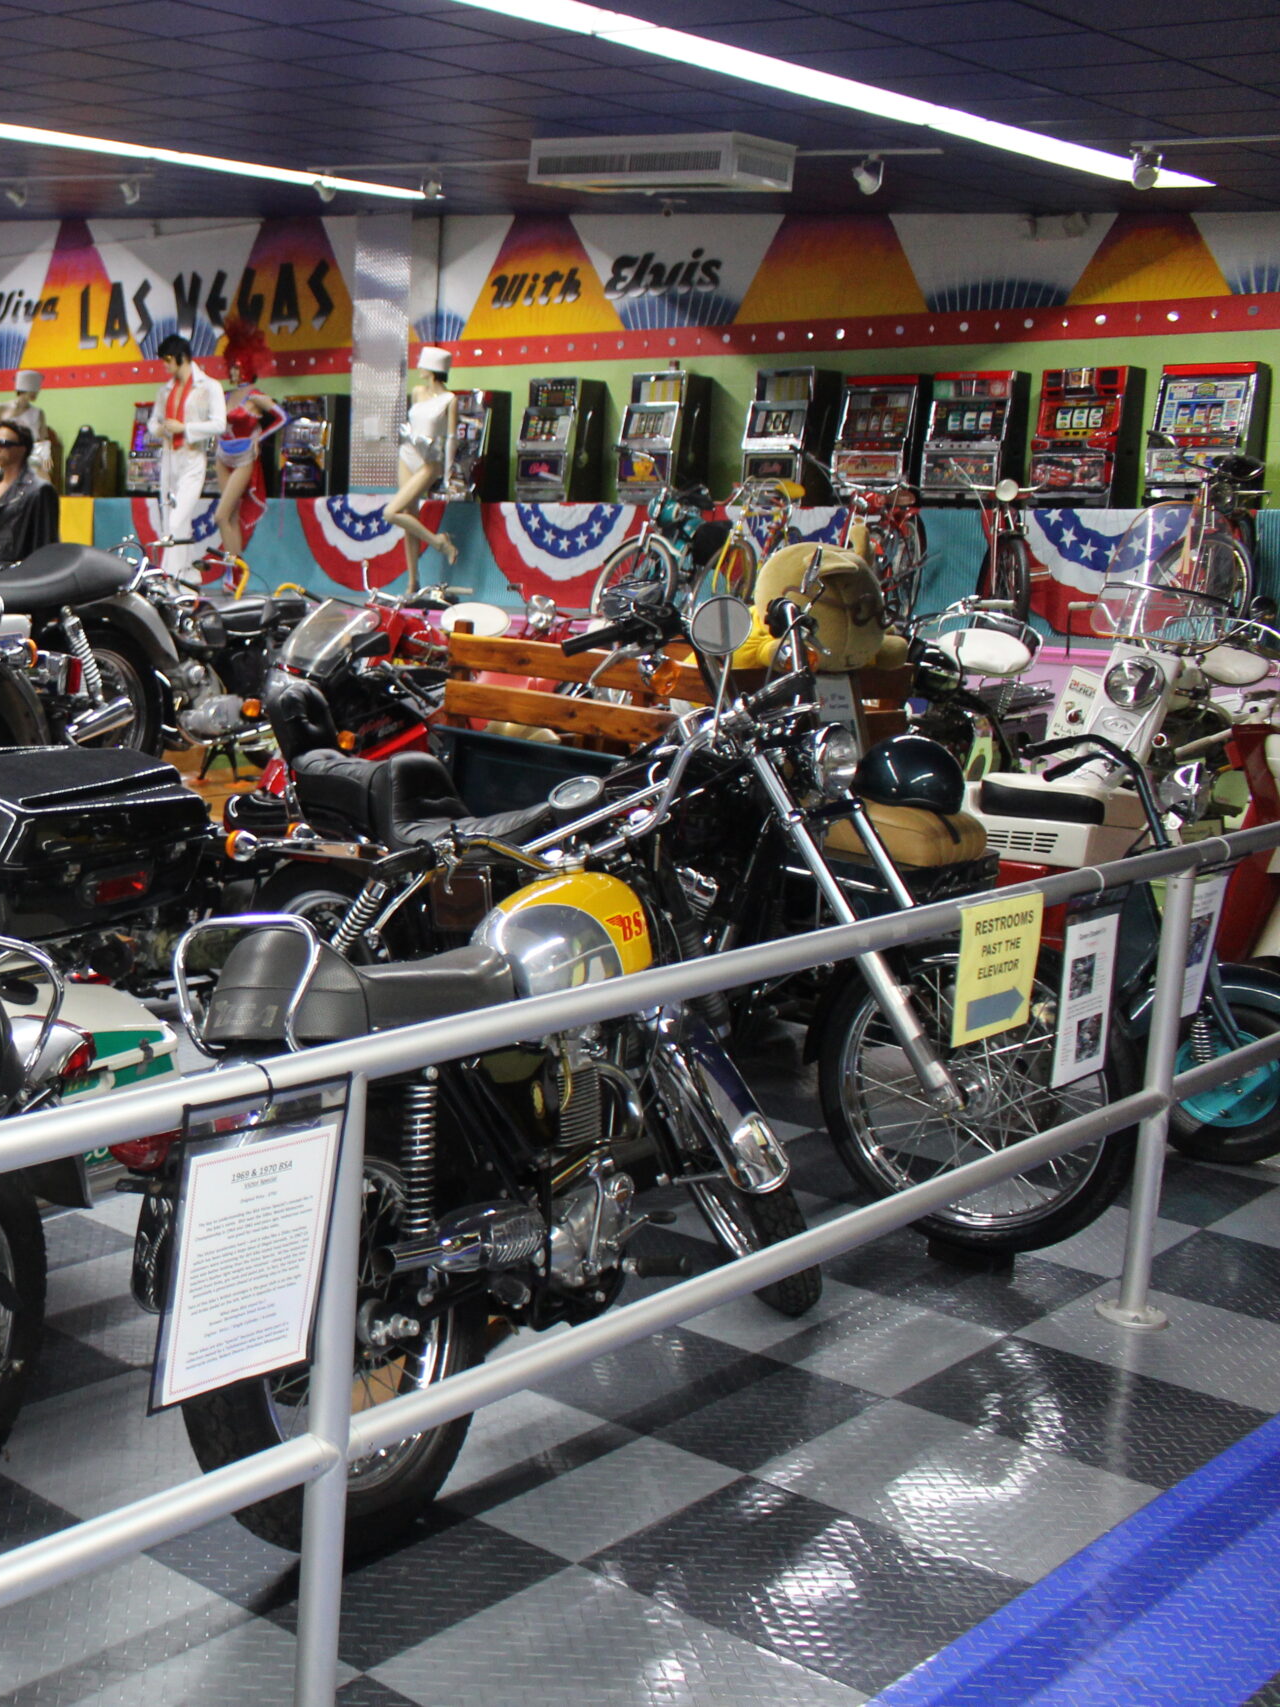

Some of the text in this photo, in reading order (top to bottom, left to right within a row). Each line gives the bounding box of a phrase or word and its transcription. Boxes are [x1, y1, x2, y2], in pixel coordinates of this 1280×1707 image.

[491, 247, 722, 309] With Elvis
[78, 279, 153, 350] LAS
[173, 259, 335, 341] VEGAS
[622, 911, 646, 942] BS
[975, 910, 1035, 937] RESTROOMS
[982, 937, 1022, 957] PAST THE
[977, 959, 1020, 980] ELEVATOR
[231, 1160, 293, 1183] 1969 & 1970 BSA
